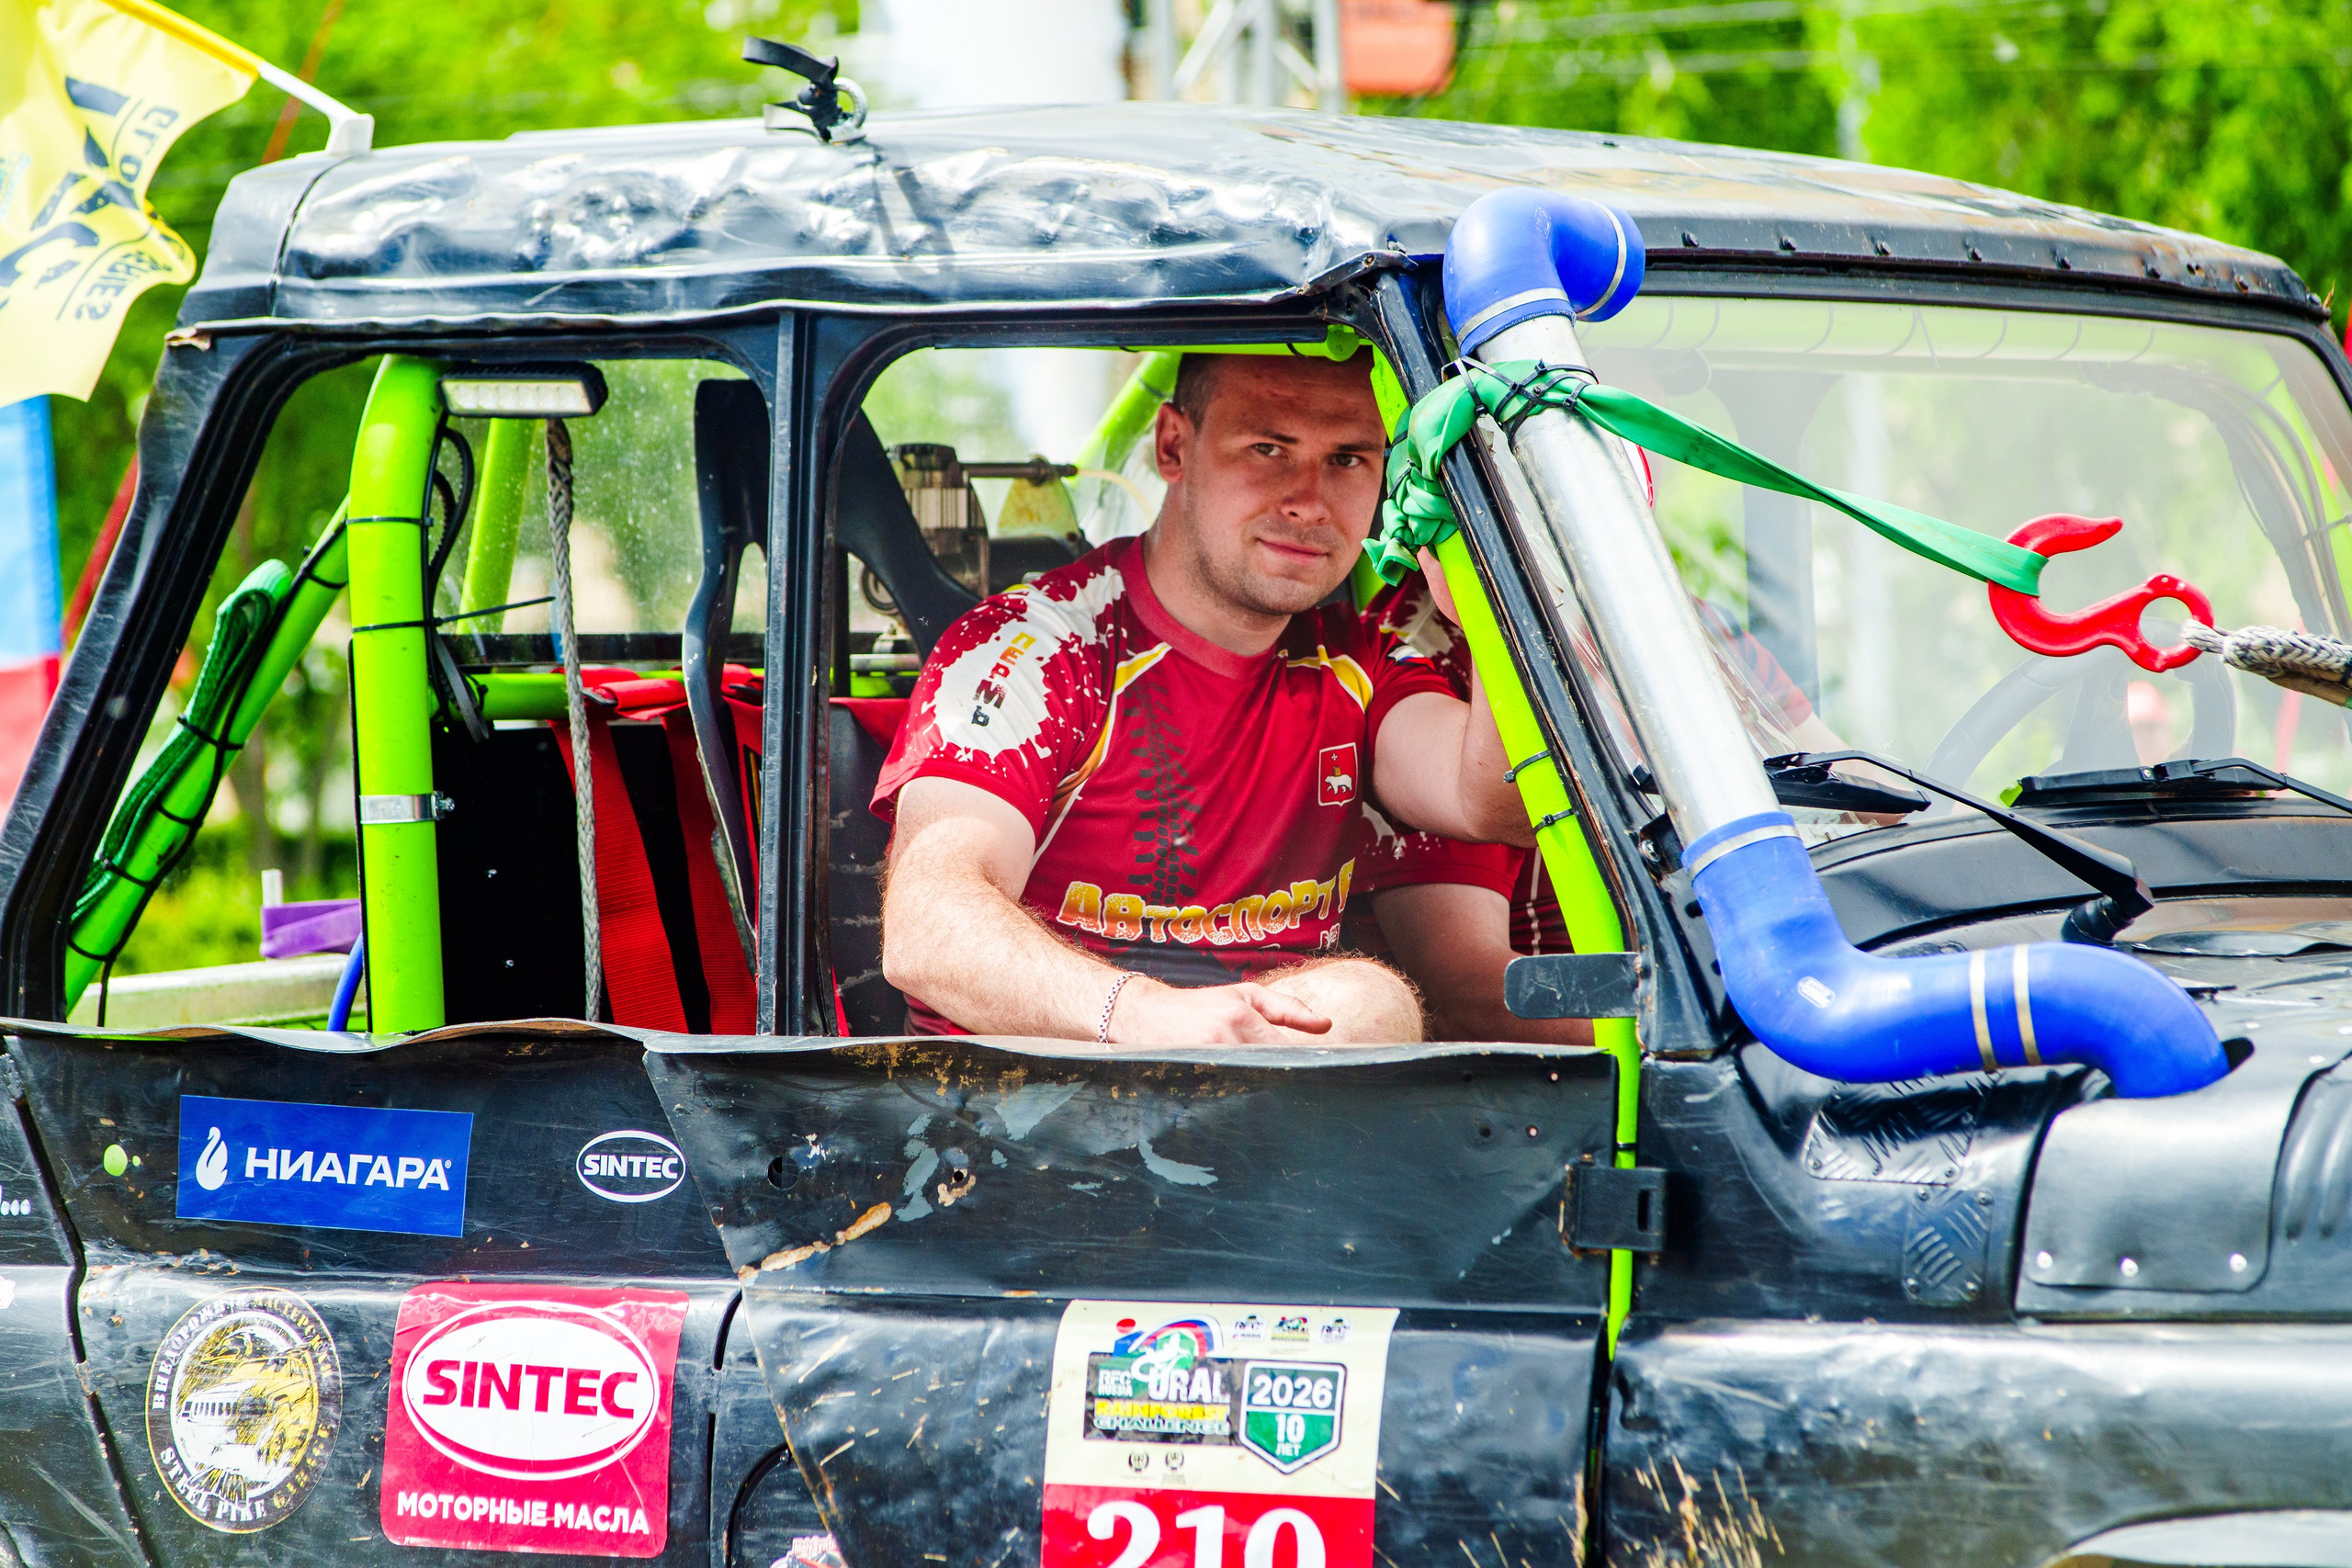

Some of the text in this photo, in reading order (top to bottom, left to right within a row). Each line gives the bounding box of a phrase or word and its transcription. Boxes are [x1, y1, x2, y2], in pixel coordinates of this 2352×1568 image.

[971, 632, 1036, 727] ПЕРМЬ
[1057, 875, 1336, 945] АВТОСПОРТ
[245, 1147, 449, 1190] НИАГАРА
[583, 1153, 679, 1180] SINTEC
[423, 1359, 638, 1419] SINTEC
[1148, 1366, 1230, 1404] URAL
[1251, 1374, 1333, 1408] 2026
[1093, 1416, 1230, 1436] CHALLENGE
[1094, 1398, 1230, 1421] RAINFOREST
[1275, 1413, 1305, 1443] 10
[1275, 1442, 1301, 1457] ЛЕТ
[160, 1446, 212, 1513] STEEL
[215, 1497, 267, 1522] PIKE
[397, 1492, 650, 1535] МОТОРНЫЕ МАСЛА
[1087, 1500, 1326, 1568] 210
